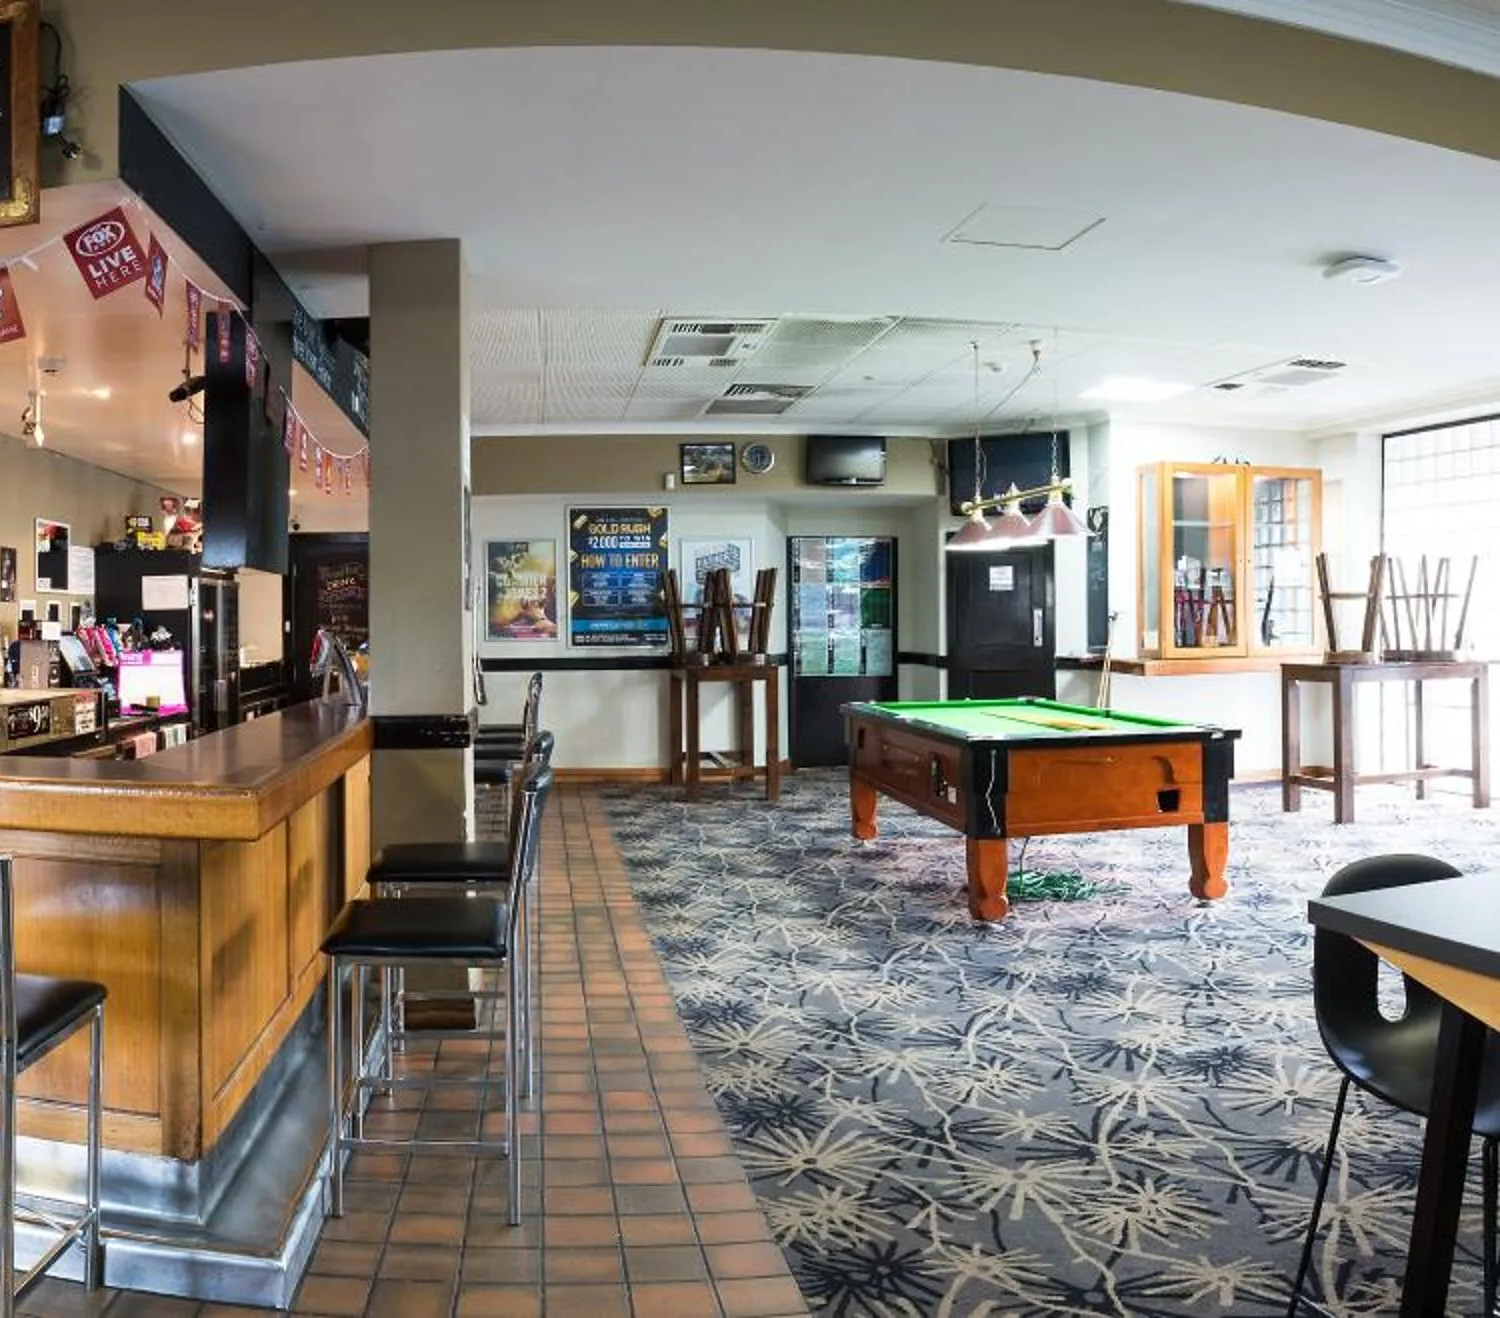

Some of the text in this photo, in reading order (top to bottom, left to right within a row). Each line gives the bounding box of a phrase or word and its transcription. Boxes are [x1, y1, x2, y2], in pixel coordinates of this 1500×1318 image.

[83, 225, 117, 249] FOX
[88, 245, 137, 279] LIVE
[93, 259, 143, 288] HERE
[588, 523, 618, 534] GOLD
[582, 553, 659, 568] HOW TO ENTER
